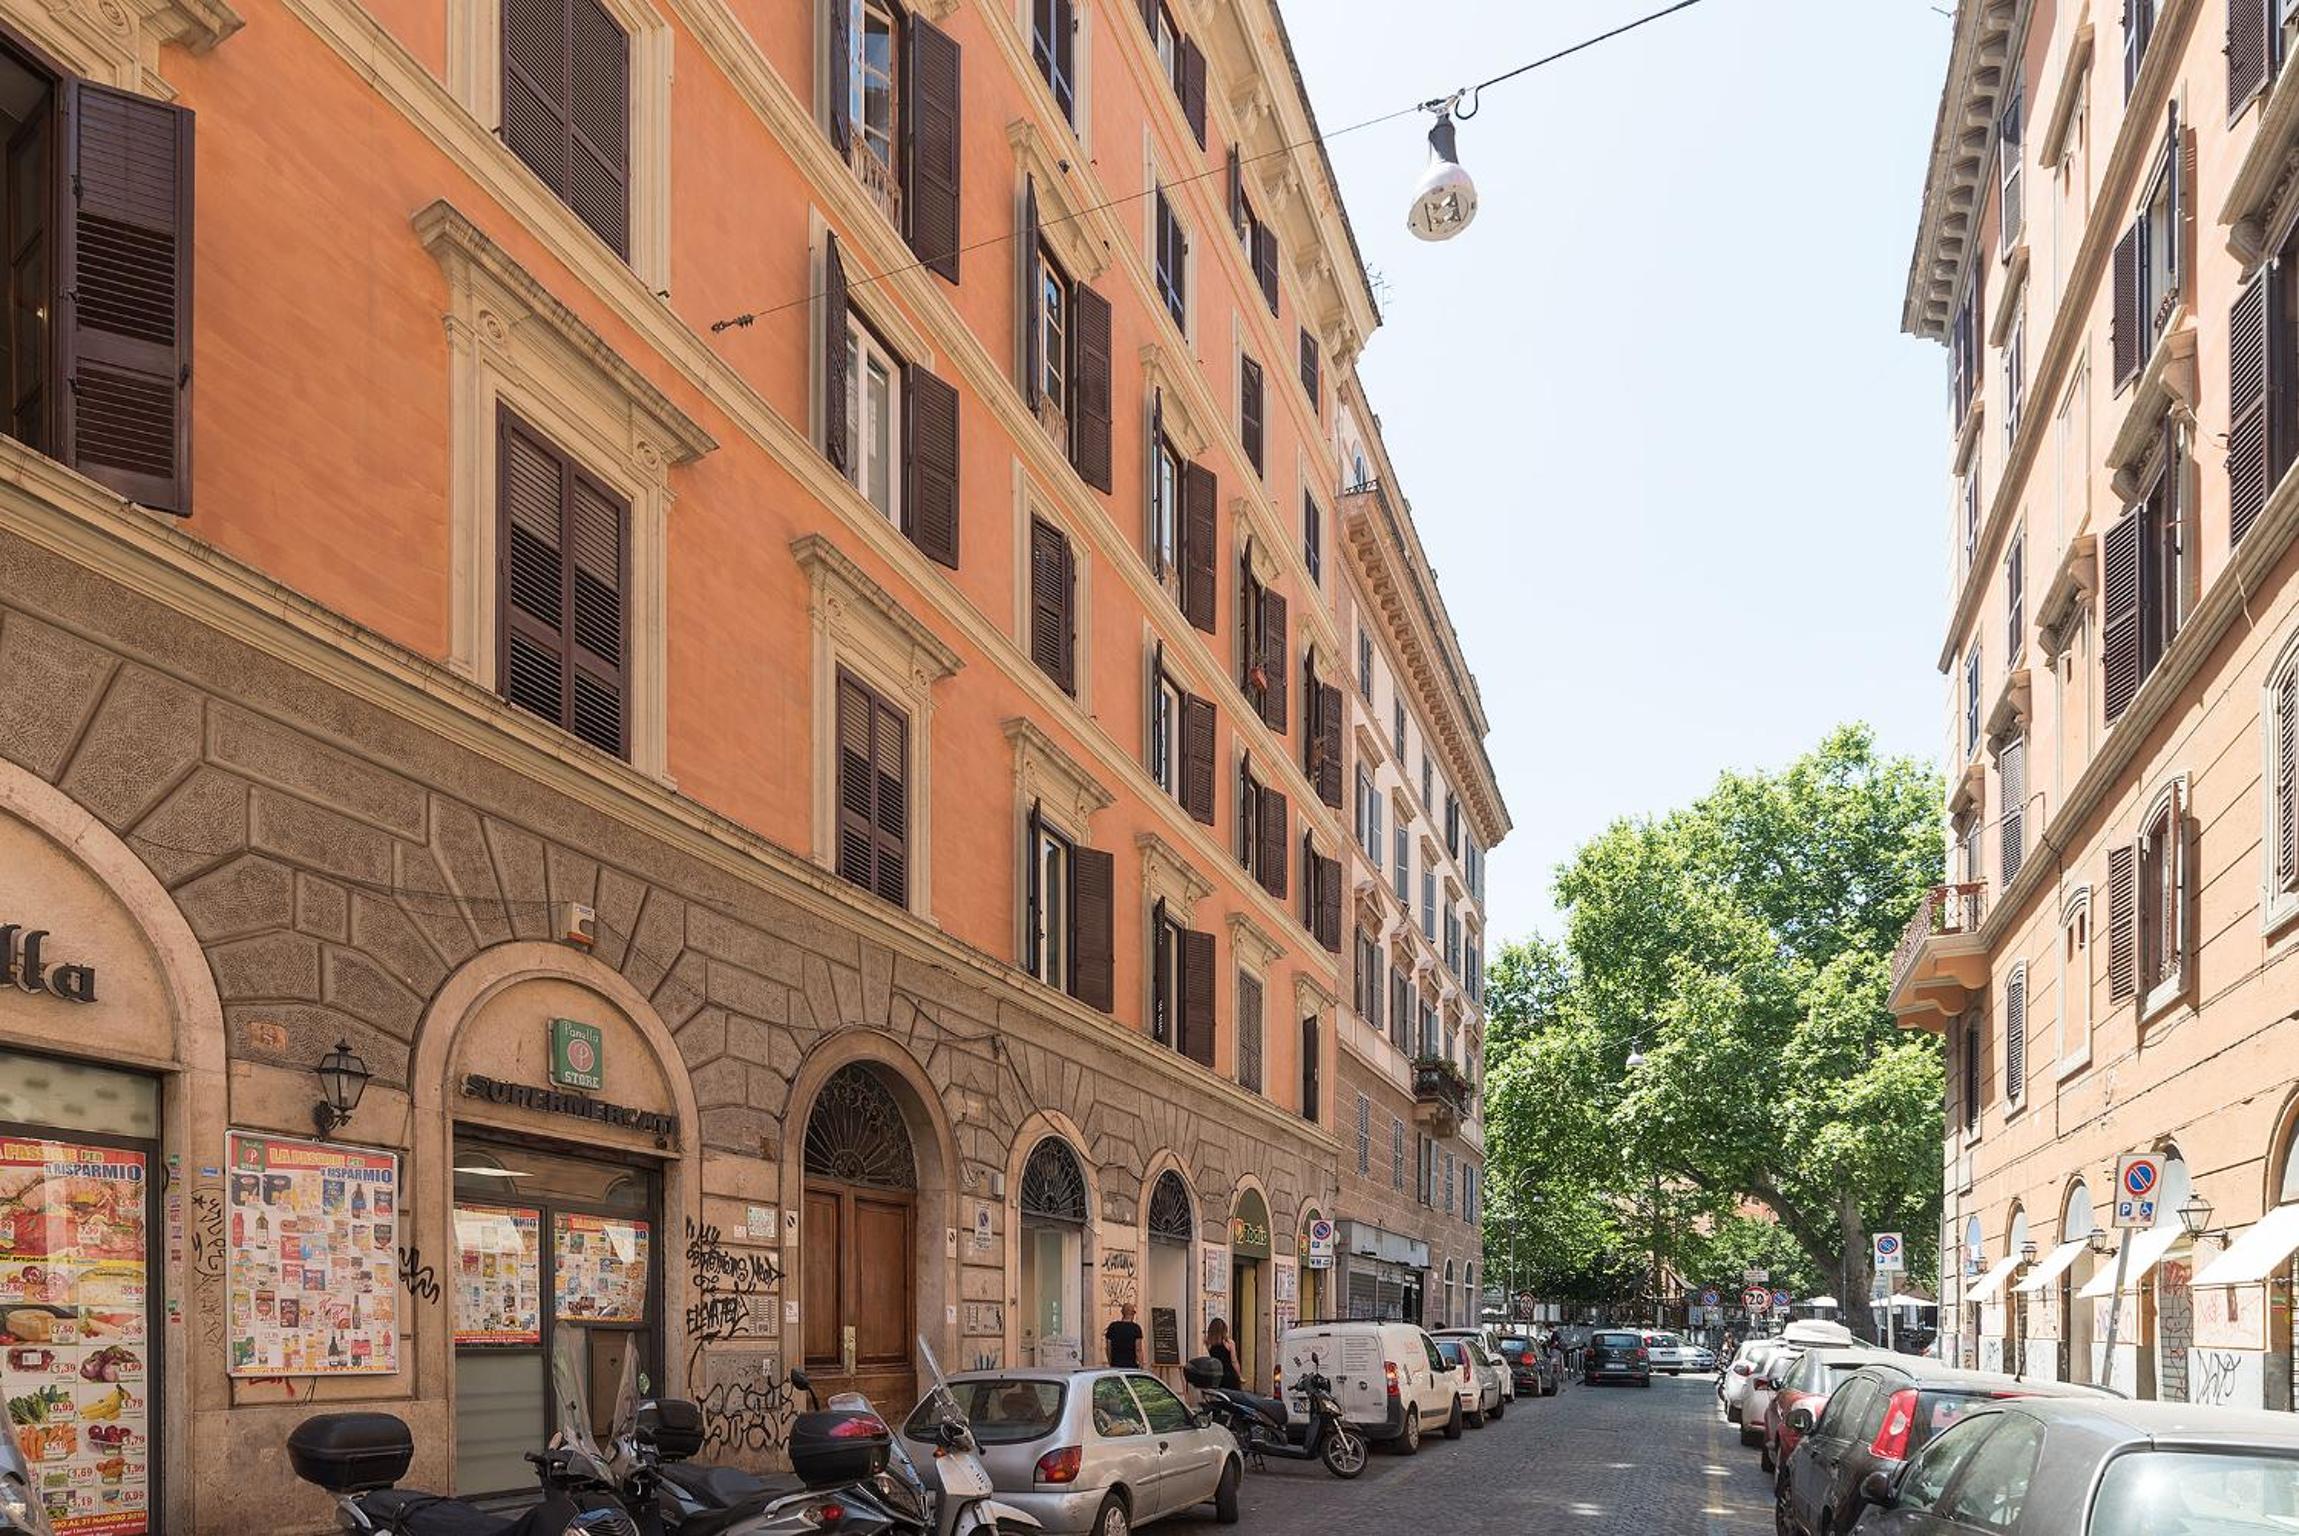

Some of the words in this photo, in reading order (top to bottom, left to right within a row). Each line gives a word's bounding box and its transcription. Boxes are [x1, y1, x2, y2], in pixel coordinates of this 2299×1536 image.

[564, 1021, 599, 1042] Panella
[564, 1071, 599, 1089] STORE
[54, 1163, 143, 1181] RISPARMIO
[327, 1168, 393, 1183] RISPARMIO
[1746, 1293, 1765, 1305] 20
